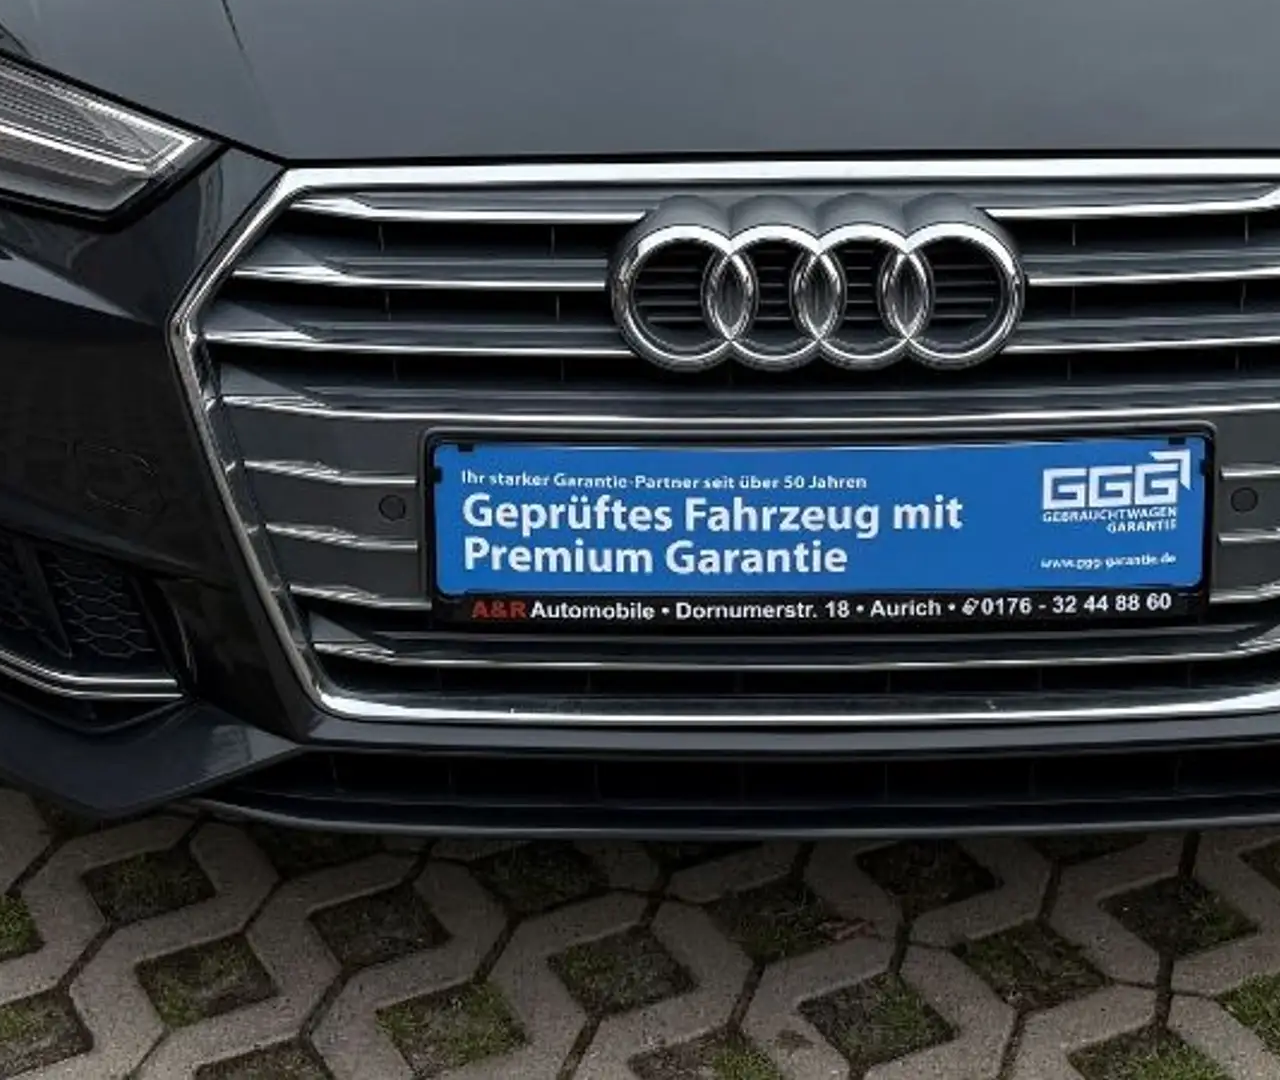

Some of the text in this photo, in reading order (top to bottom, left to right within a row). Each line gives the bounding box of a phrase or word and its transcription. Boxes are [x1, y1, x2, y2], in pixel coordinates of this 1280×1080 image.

[462, 470, 868, 490] Ihr starker Garantie-Partner seit über 50 Jahren
[1043, 463, 1179, 510] GGG
[463, 492, 964, 539] Geprüftes Fahrzeug mit
[1043, 507, 1178, 523] GEBRAUCHTWAGEN
[1106, 519, 1178, 534] GARANTIE
[464, 536, 848, 574] Premium Garantie
[472, 600, 527, 619] A&R
[530, 601, 656, 620] Automobile
[676, 602, 818, 620] Dornumerstr.
[825, 600, 850, 618] 18
[870, 599, 942, 618] Aurich
[982, 597, 1033, 615] 0176
[1053, 595, 1077, 614] 32
[1084, 595, 1109, 612] 44
[1116, 593, 1140, 611] 88
[1147, 592, 1171, 610] 60
